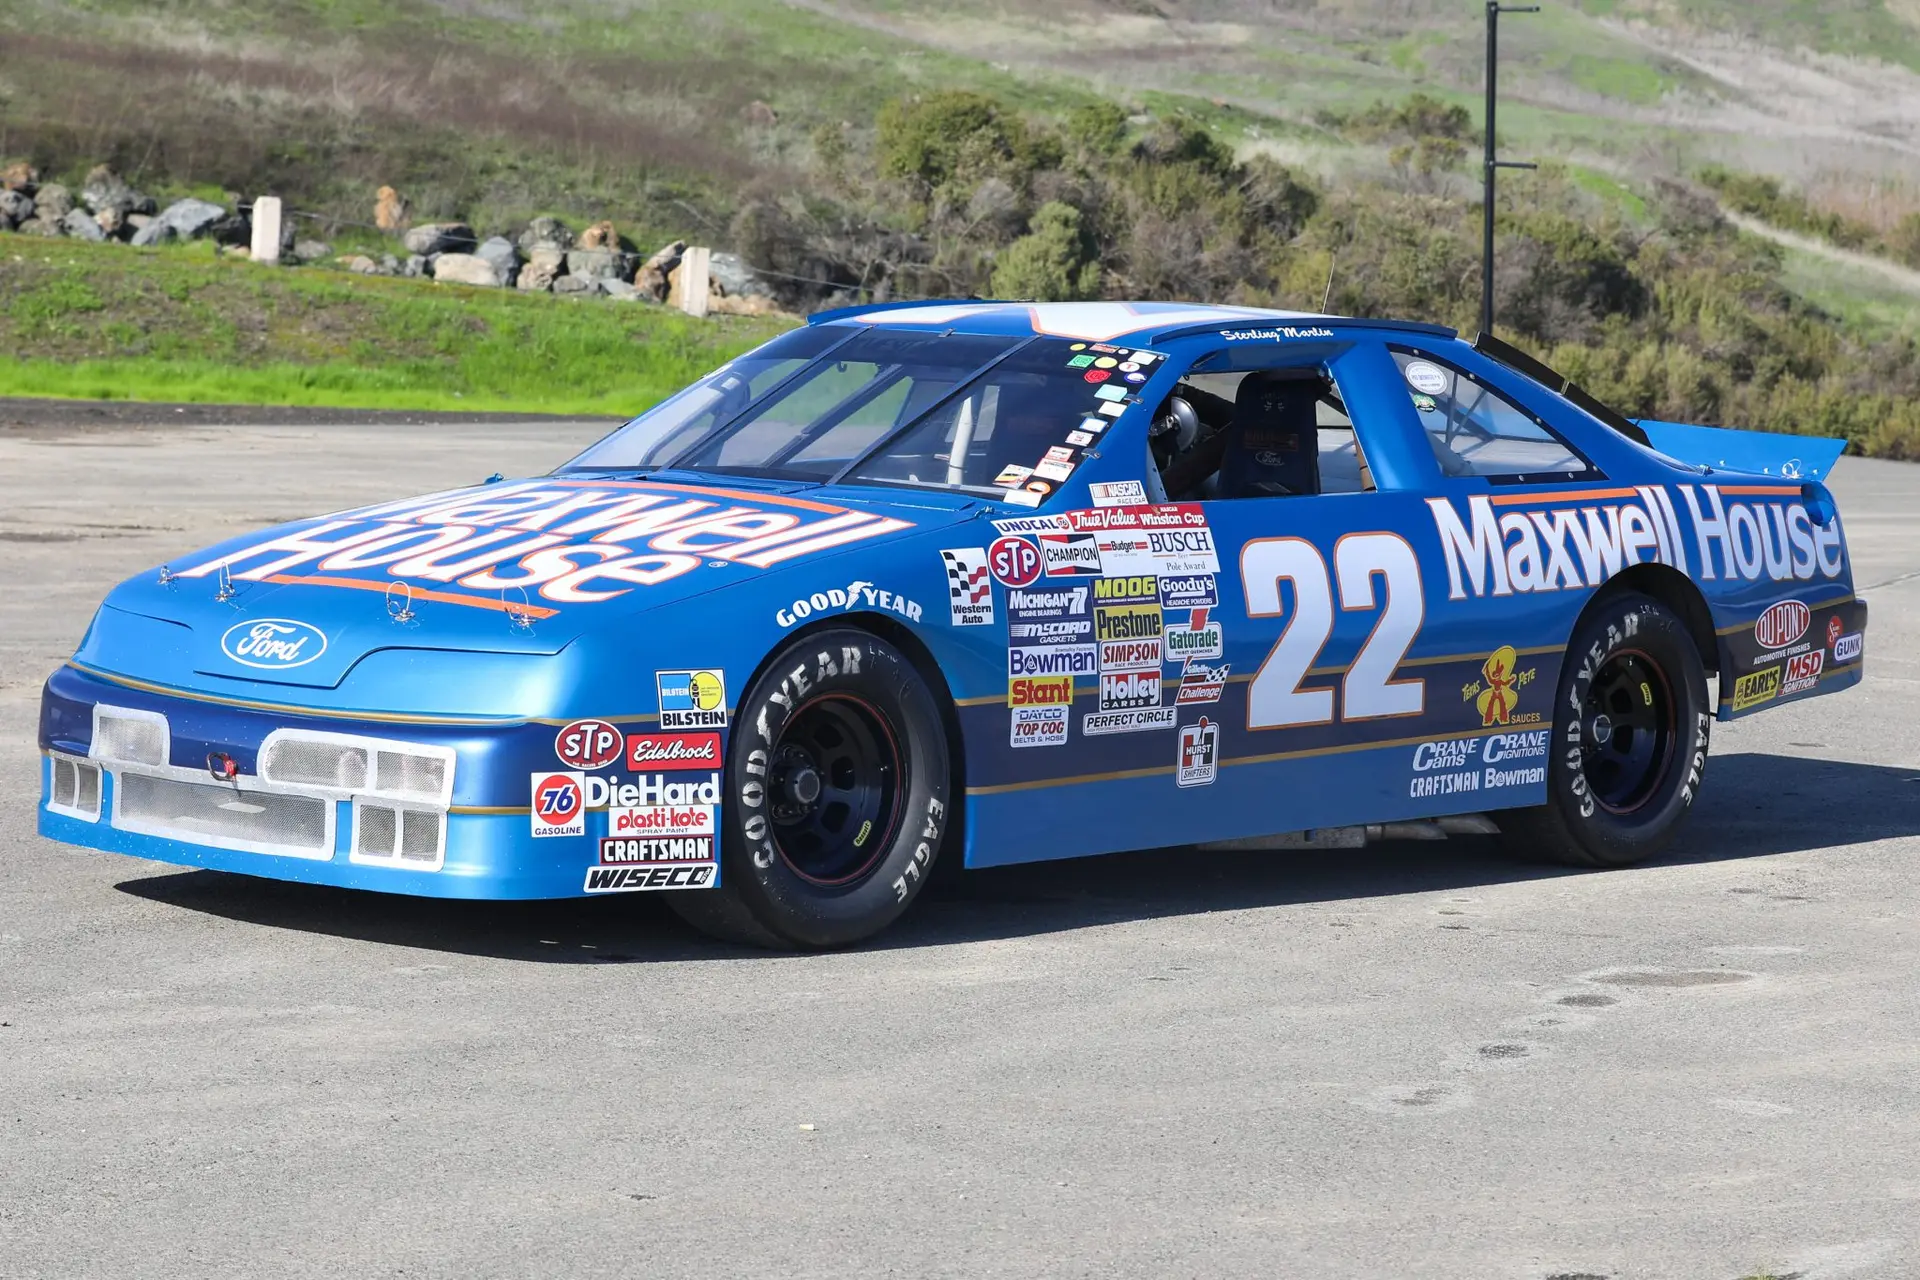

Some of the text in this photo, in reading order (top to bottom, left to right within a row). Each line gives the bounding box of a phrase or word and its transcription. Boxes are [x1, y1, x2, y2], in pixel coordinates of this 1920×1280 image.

[1220, 327, 1334, 342] Sterling Marlin
[1107, 483, 1141, 497] NASCAR
[996, 518, 1059, 532] UNOCAL
[1139, 512, 1205, 526] Winston Cup
[1147, 531, 1211, 553] BUSCH
[1424, 484, 1692, 600] Maxwell
[1676, 484, 1842, 580] House
[1046, 546, 1098, 563] CHAMPION
[1111, 540, 1136, 553] Budget
[172, 520, 702, 602] House
[996, 540, 1036, 579] STP
[1166, 561, 1206, 571] Pole Award
[1094, 576, 1156, 598] MOOG
[1161, 576, 1214, 597] Goody's
[953, 605, 991, 614] Western
[1067, 586, 1088, 614] 77
[1166, 597, 1213, 607] HEADACHE POWDERS
[962, 615, 983, 624] Auto
[1018, 608, 1062, 617] ENGINE BEARINGS
[1096, 609, 1160, 639] Prestone
[1240, 530, 1426, 731] 22
[236, 622, 308, 661] Ford
[1039, 634, 1077, 643] GASKETS
[1168, 629, 1219, 649] Gatorade
[1836, 638, 1860, 657] GUNK
[1103, 642, 1159, 664] SIMPSON
[1753, 642, 1811, 665] AUTOMOTIVE FINISHES
[1787, 652, 1822, 681] MSD
[1012, 677, 1071, 705] Stant
[1102, 675, 1159, 705] Holley
[1180, 686, 1220, 699] Challenge
[1743, 669, 1779, 699] EARL'S
[1782, 675, 1817, 694] IGNITION
[1019, 708, 1063, 720] DAYCO
[1102, 699, 1145, 708] CARBS
[662, 712, 725, 726] BILSTEIN
[1087, 710, 1173, 729] PERFECT CIRCLE
[1511, 712, 1541, 723] SAUCES
[1013, 736, 1036, 744] BELTS
[1044, 734, 1065, 742] HOSE
[1015, 721, 1065, 736] TOP COG
[564, 724, 613, 759] STP
[634, 740, 715, 761] Edelbrock
[1186, 744, 1211, 756] HURST
[1412, 731, 1548, 771] CRANE CRANE
[1502, 746, 1546, 760] IGNITIONS
[1681, 712, 1709, 807] EAGLE
[1184, 767, 1210, 779] SHIFTERS
[585, 773, 720, 807] DieHard
[1410, 771, 1480, 798] CRAFTSMAN
[540, 784, 577, 815] 76
[617, 807, 708, 831] plasti-kote
[534, 826, 582, 836] GASOLINE
[604, 838, 709, 862] CRAFTSMAN
[892, 797, 943, 903] EAGLE
[588, 866, 713, 889] WISECO
